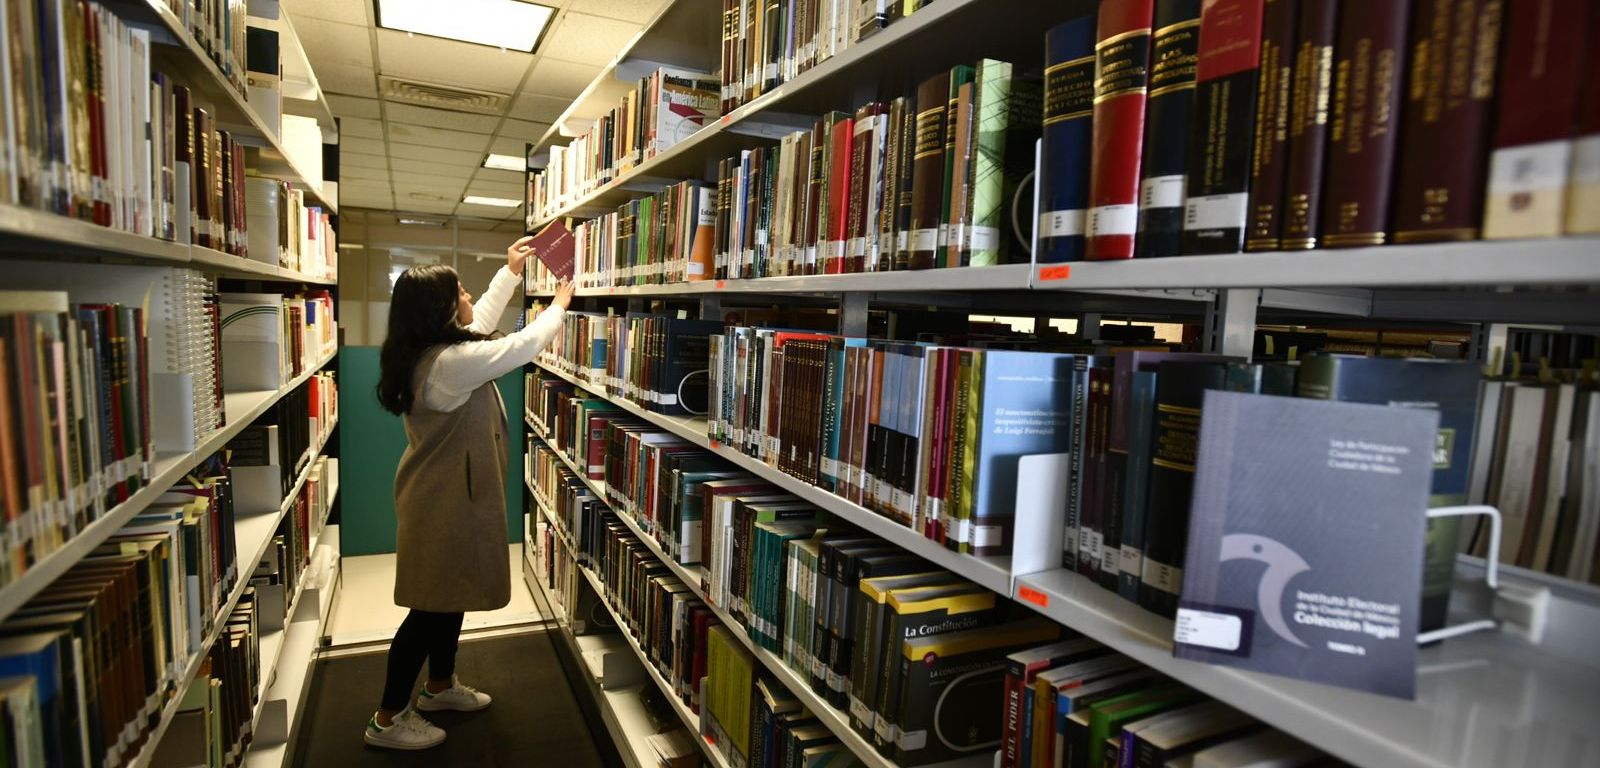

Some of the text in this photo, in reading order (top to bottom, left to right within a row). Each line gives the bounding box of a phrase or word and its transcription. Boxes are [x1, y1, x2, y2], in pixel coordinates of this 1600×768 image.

[823, 362, 834, 456] INSTITUCIONALISMO
[1329, 439, 1345, 450] Ley
[1296, 590, 1400, 615] Instituto Electoral
[1296, 601, 1308, 612] de
[1320, 604, 1353, 618] Ciudad
[905, 615, 978, 638] La Constitución
[1293, 610, 1400, 639] Colección legal
[1007, 689, 1019, 760] DEL PODER
